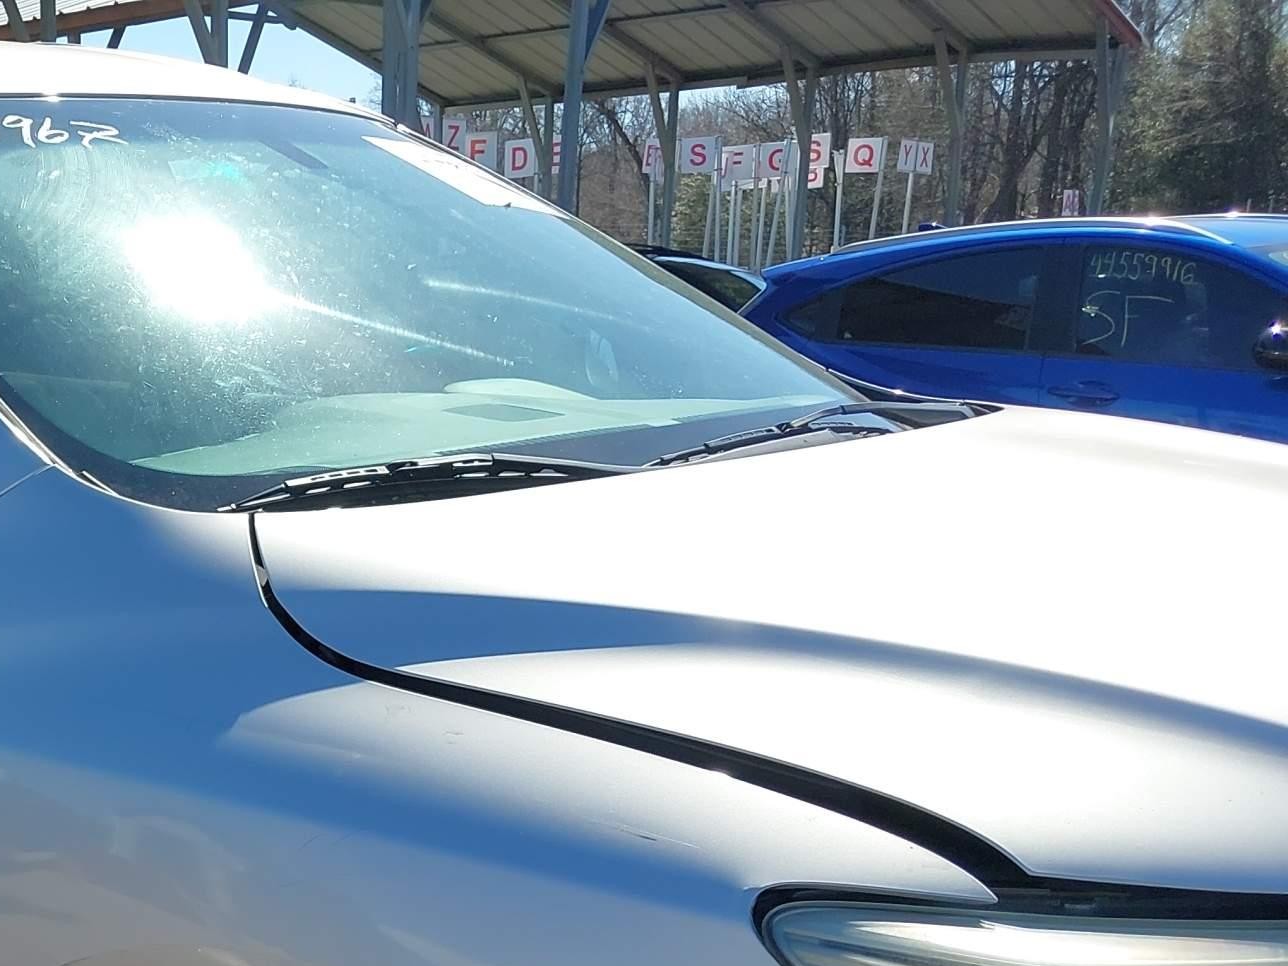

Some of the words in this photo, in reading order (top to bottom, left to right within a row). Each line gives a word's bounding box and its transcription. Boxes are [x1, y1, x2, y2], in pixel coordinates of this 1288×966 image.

[447, 125, 460, 150] Z
[512, 147, 528, 171] D
[689, 144, 706, 166] S
[854, 144, 873, 167] Q
[904, 144, 912, 166] Y
[920, 147, 929, 168] X
[1082, 291, 1175, 347] SF
